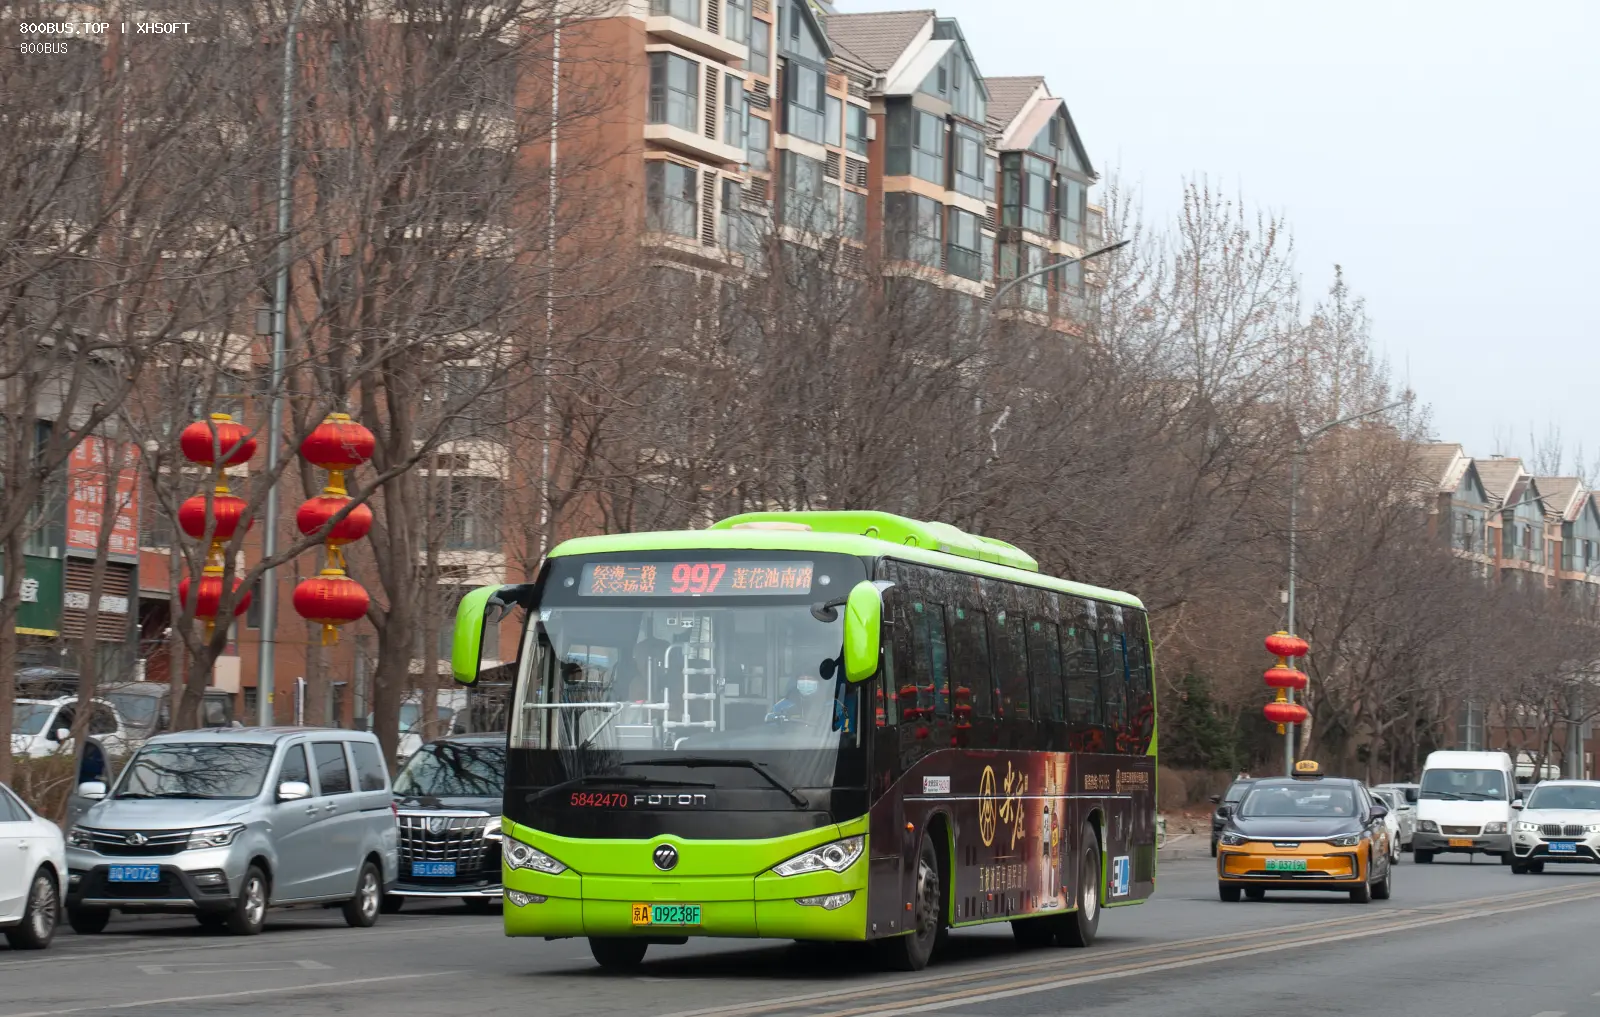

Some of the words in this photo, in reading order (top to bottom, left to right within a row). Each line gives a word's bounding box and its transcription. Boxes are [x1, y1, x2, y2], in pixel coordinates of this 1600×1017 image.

[592, 564, 657, 580] 经海二路
[671, 563, 727, 593] 997
[732, 567, 814, 590] 莲花池南路
[591, 579, 656, 594] 公交场站
[570, 792, 628, 808] 5842470
[633, 794, 707, 806] FOTON
[654, 906, 701, 922] 09238F
